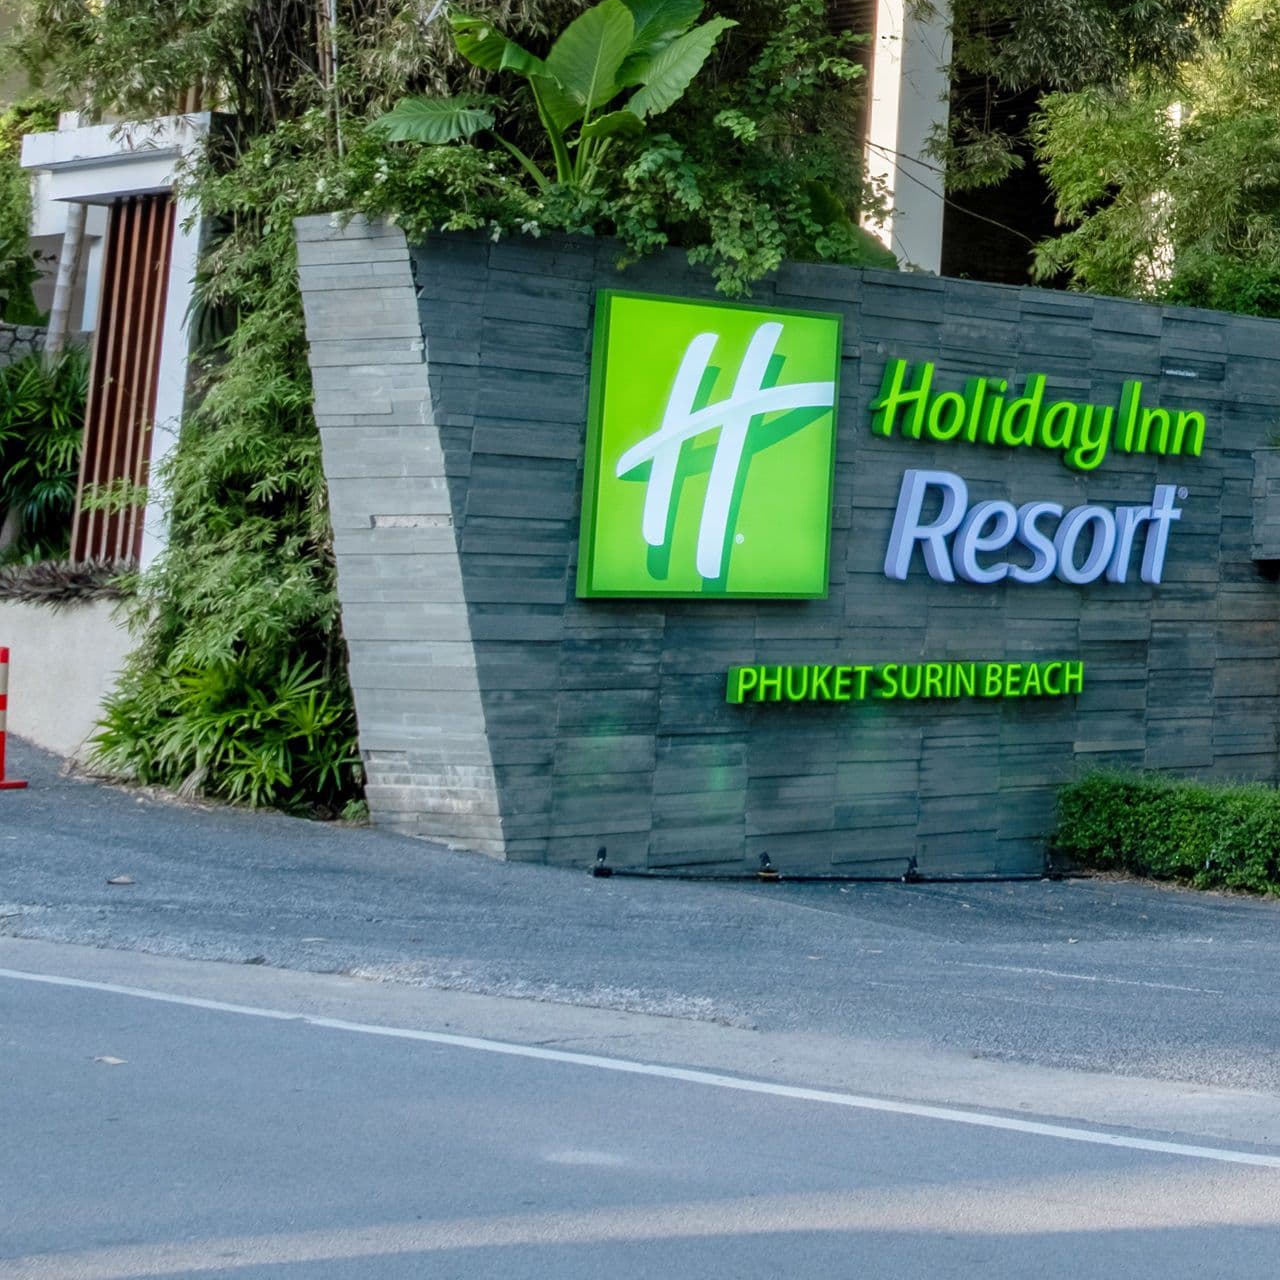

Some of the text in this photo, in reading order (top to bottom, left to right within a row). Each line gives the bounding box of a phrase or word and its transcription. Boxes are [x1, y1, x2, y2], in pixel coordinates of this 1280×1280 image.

[870, 358, 1206, 470] Holiday Inn
[884, 469, 1182, 585] Resort
[727, 661, 1084, 703] PHUKET SURIN BEACH
